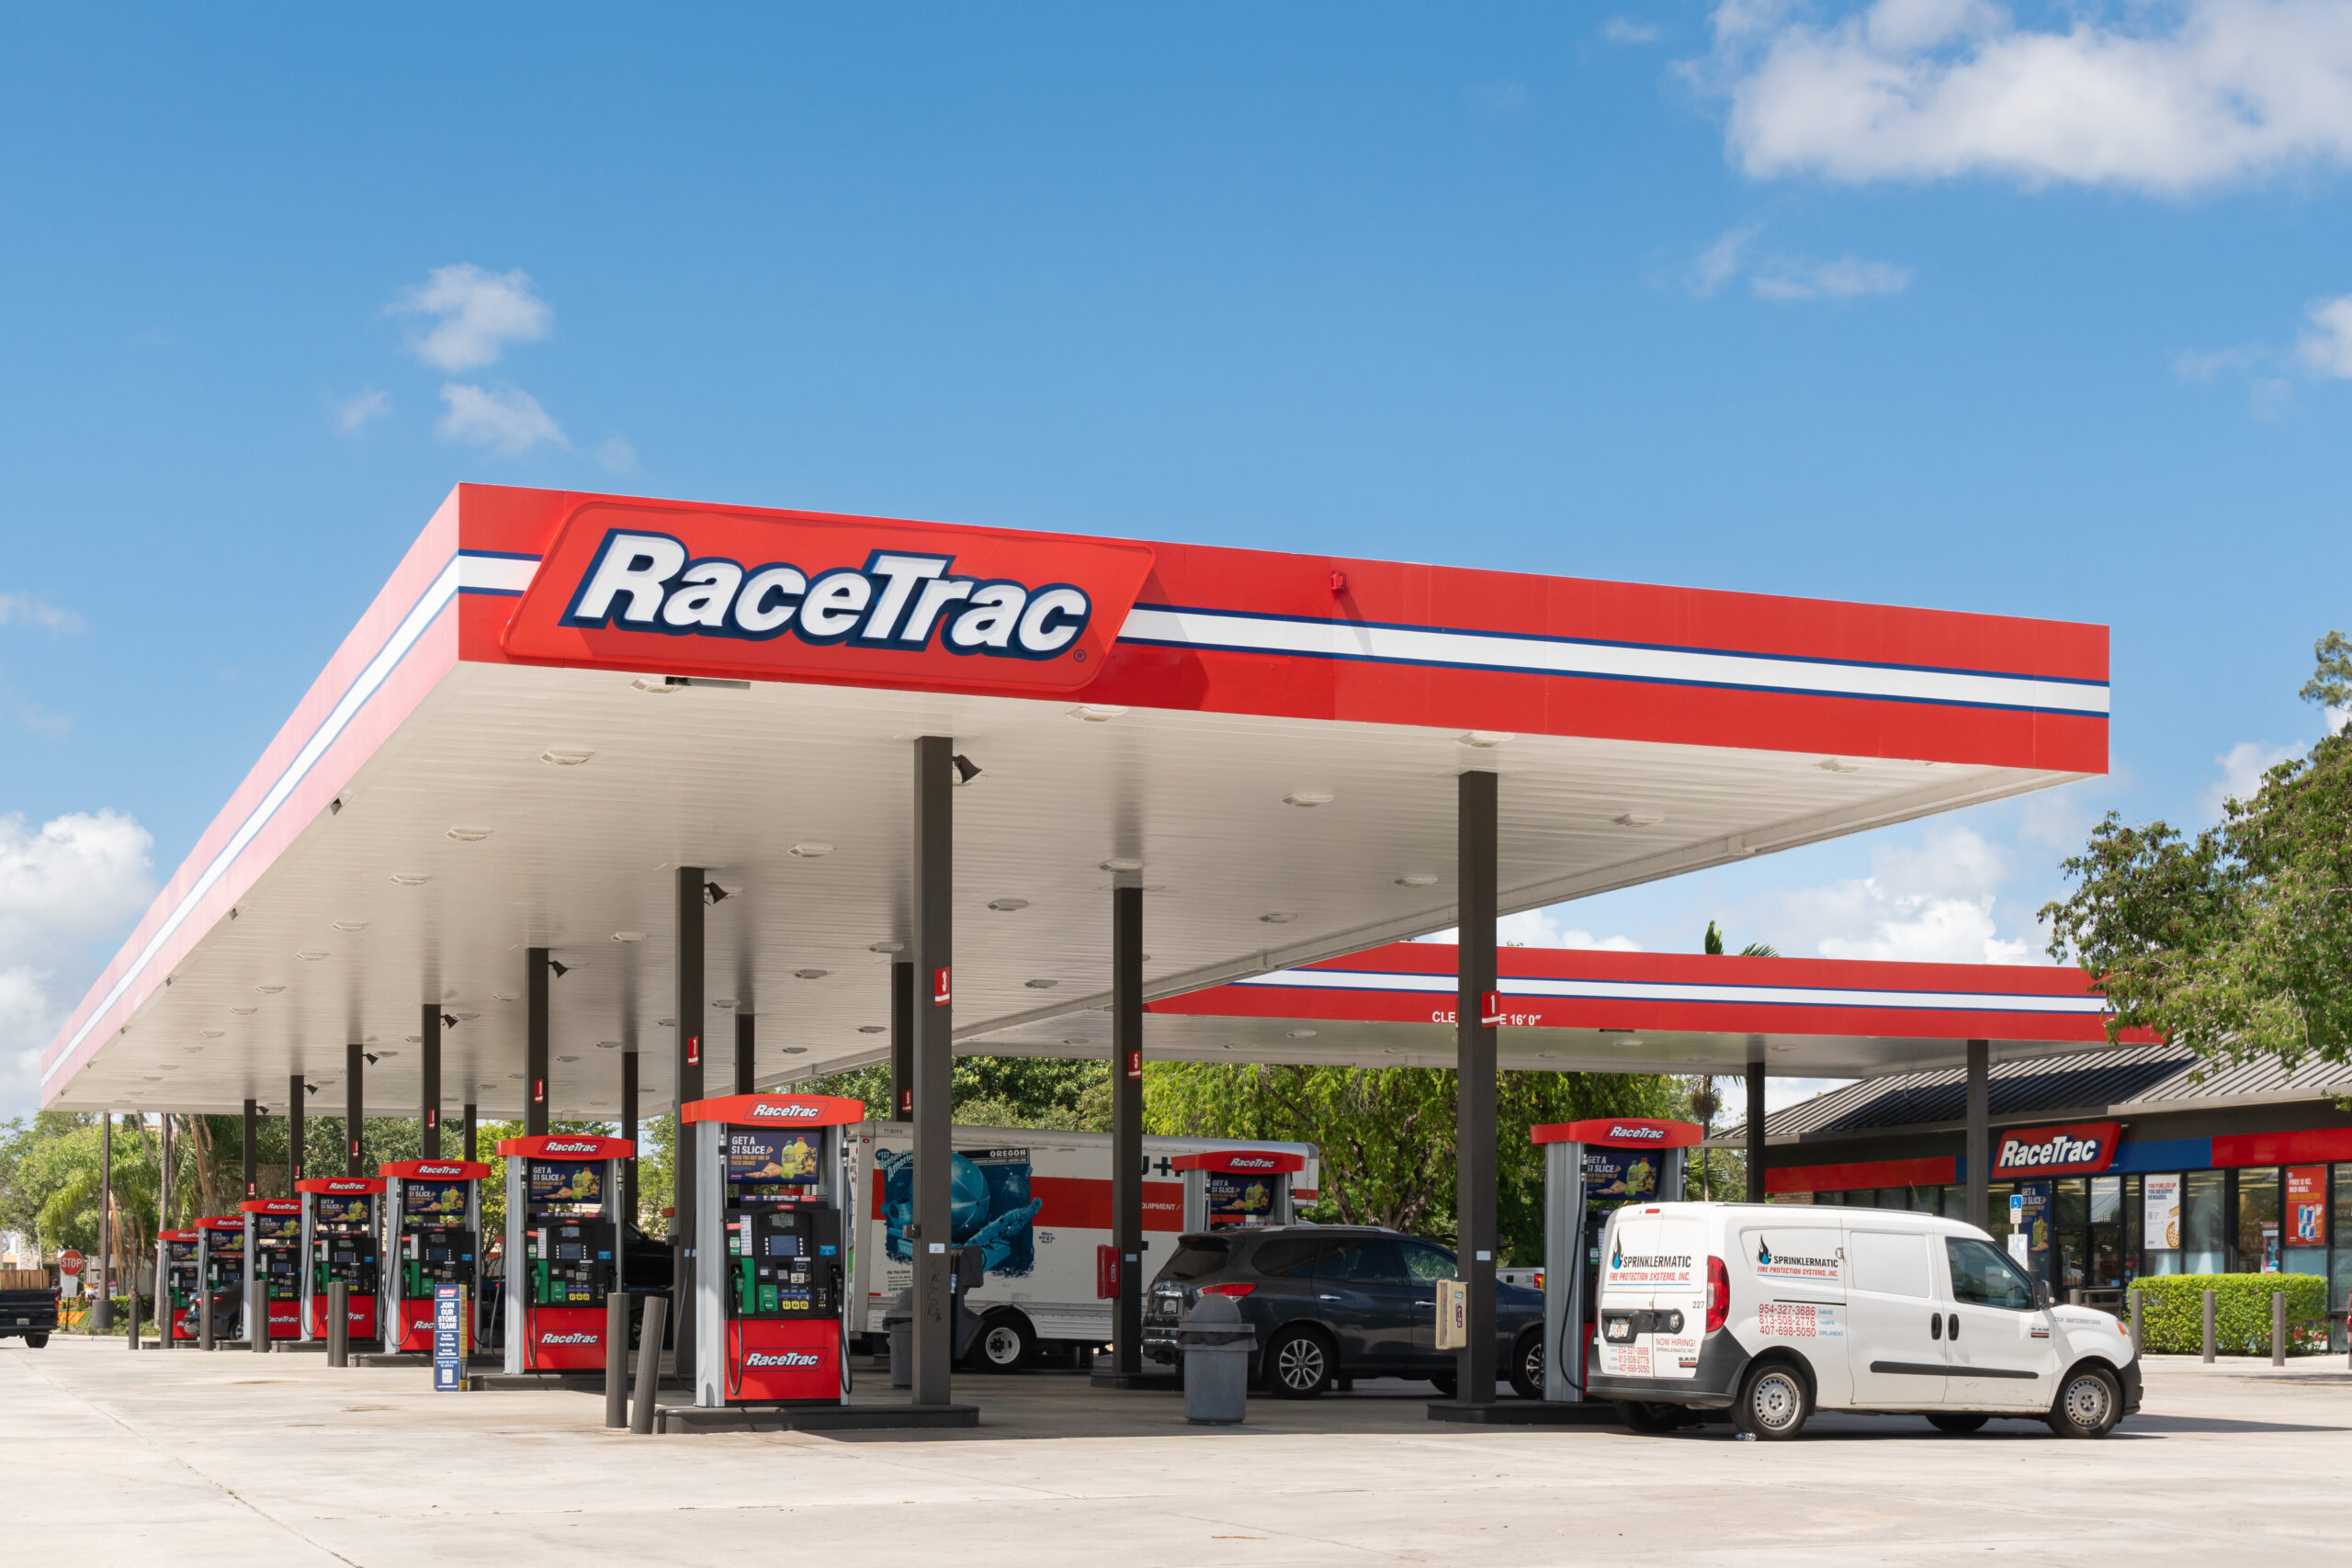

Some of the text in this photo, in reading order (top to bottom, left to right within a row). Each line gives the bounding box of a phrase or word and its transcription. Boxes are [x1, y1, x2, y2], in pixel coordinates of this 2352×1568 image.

[565, 530, 1091, 656] RaceTrac
[1490, 994, 1496, 1014] 1
[752, 1104, 820, 1118] RaceTrac
[1609, 1126, 1665, 1139] RaceTrac
[731, 1136, 756, 1145] GET A
[546, 1142, 597, 1152] RaceTrac
[731, 1145, 765, 1155] $1 SLICE
[1999, 1135, 2098, 1168] RaceTrac
[989, 1149, 1026, 1157] OREGON
[1229, 1157, 1275, 1168] RaceTrac
[1587, 1156, 1607, 1164] GET A
[419, 1165, 461, 1175] RaceTrac
[1594, 1164, 1614, 1173] SLICE
[329, 1182, 366, 1190] RaceTrac
[2022, 1188, 2036, 1196] GET A
[2027, 1196, 2042, 1205] SLICE
[62, 1258, 82, 1268] STOP
[1623, 1255, 1691, 1268] SPRINKLERMATIC
[1774, 1255, 1838, 1268] SPRINKLERMATIC
[1609, 1272, 1619, 1281] FIRE
[1619, 1272, 1648, 1281] PROTECTION
[1678, 1272, 1690, 1281] INC.
[1770, 1266, 1801, 1275] PROTECTION
[1802, 1269, 1827, 1277] SYSTEMS,
[1759, 1303, 1815, 1316] 954-327-3686
[1759, 1314, 1815, 1327] 813-508-2776
[1760, 1325, 1816, 1337] 407-698-5050
[541, 1333, 598, 1344] RaceTrac
[1671, 1339, 1696, 1347] HIRING!
[746, 1352, 819, 1367] RaceTrac
